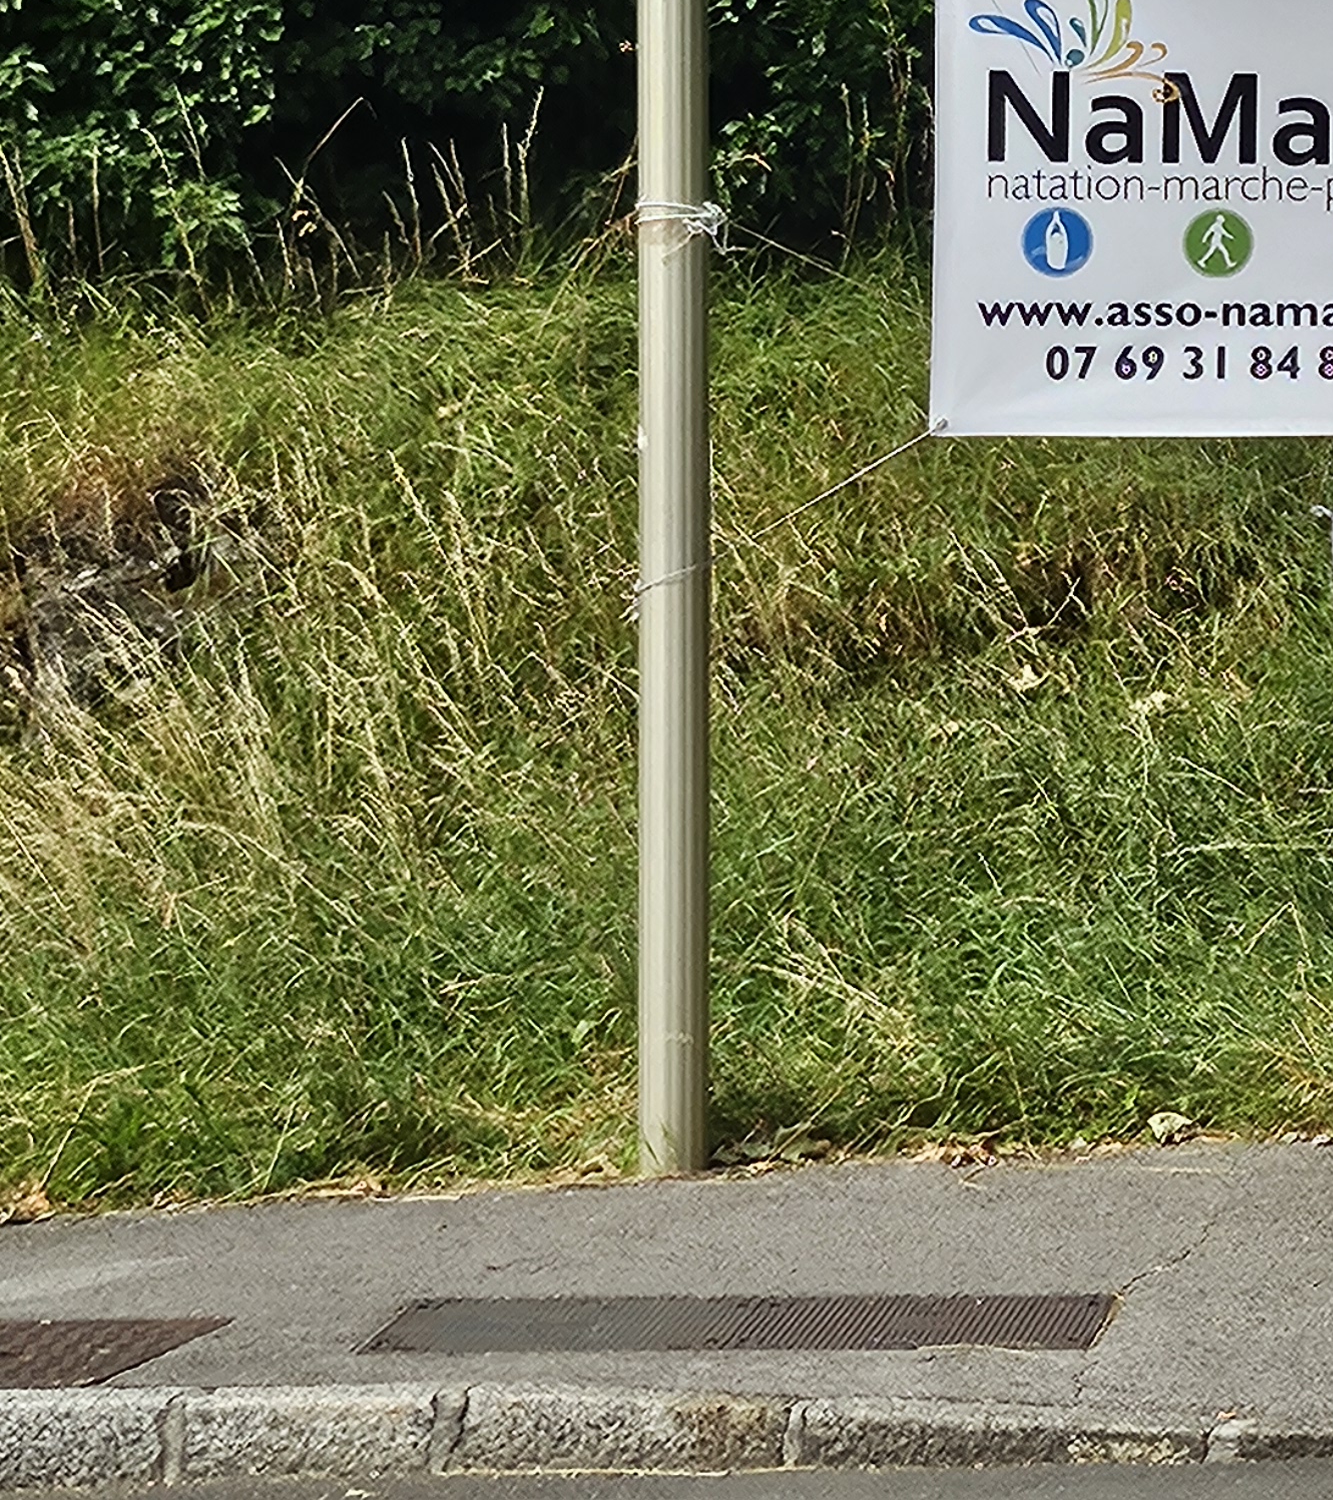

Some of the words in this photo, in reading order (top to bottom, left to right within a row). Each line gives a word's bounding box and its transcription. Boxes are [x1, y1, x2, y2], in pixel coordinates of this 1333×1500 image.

[1045, 347, 1098, 380] 07
[1114, 347, 1166, 380] 69
[1182, 347, 1226, 380] 31
[1249, 347, 1300, 380] 84
